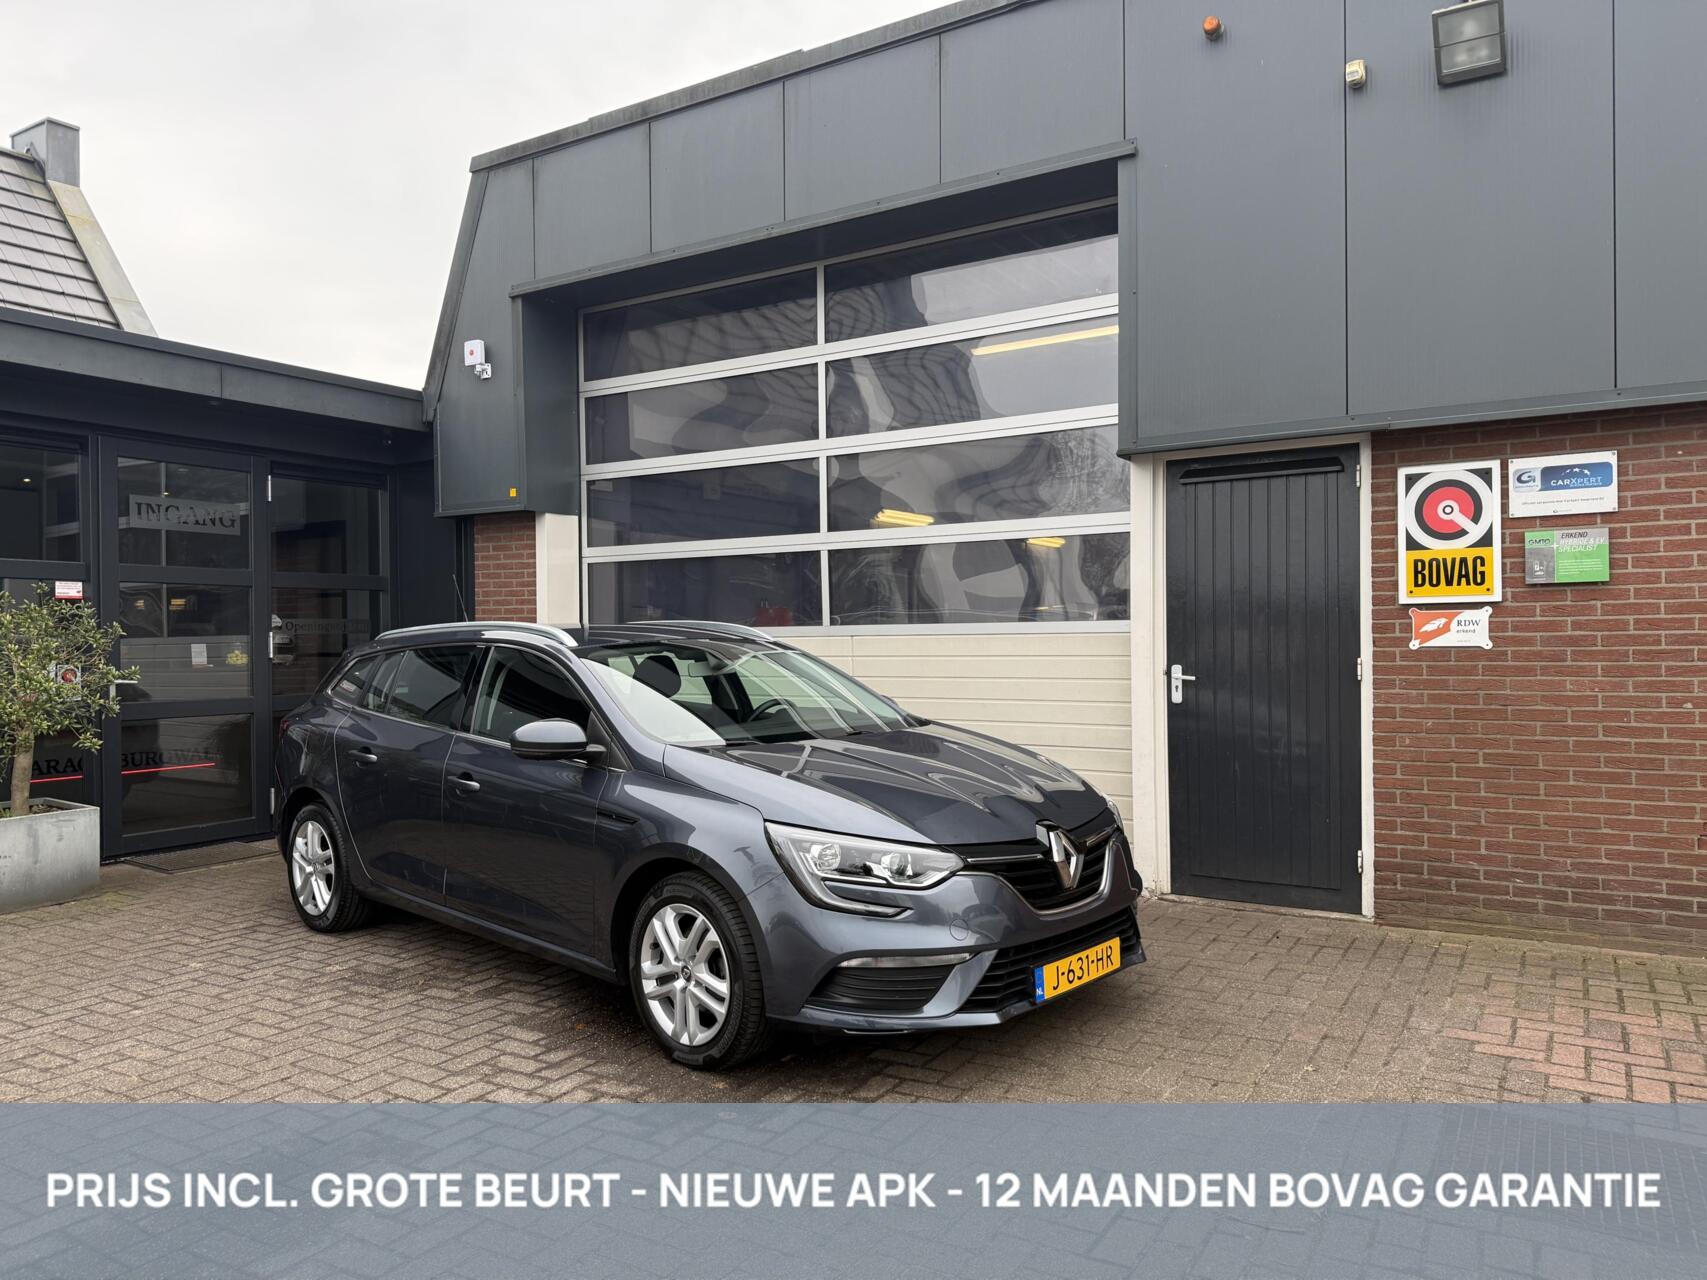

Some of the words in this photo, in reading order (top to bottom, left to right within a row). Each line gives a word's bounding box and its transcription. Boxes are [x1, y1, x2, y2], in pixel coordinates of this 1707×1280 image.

[1551, 477, 1602, 486] CARXPERT
[135, 502, 237, 529] INGANG
[1561, 531, 1588, 539] ERKEND
[1413, 556, 1486, 588] BOVAG
[1456, 619, 1481, 627] RDW
[1052, 944, 1114, 991] J-631-HR
